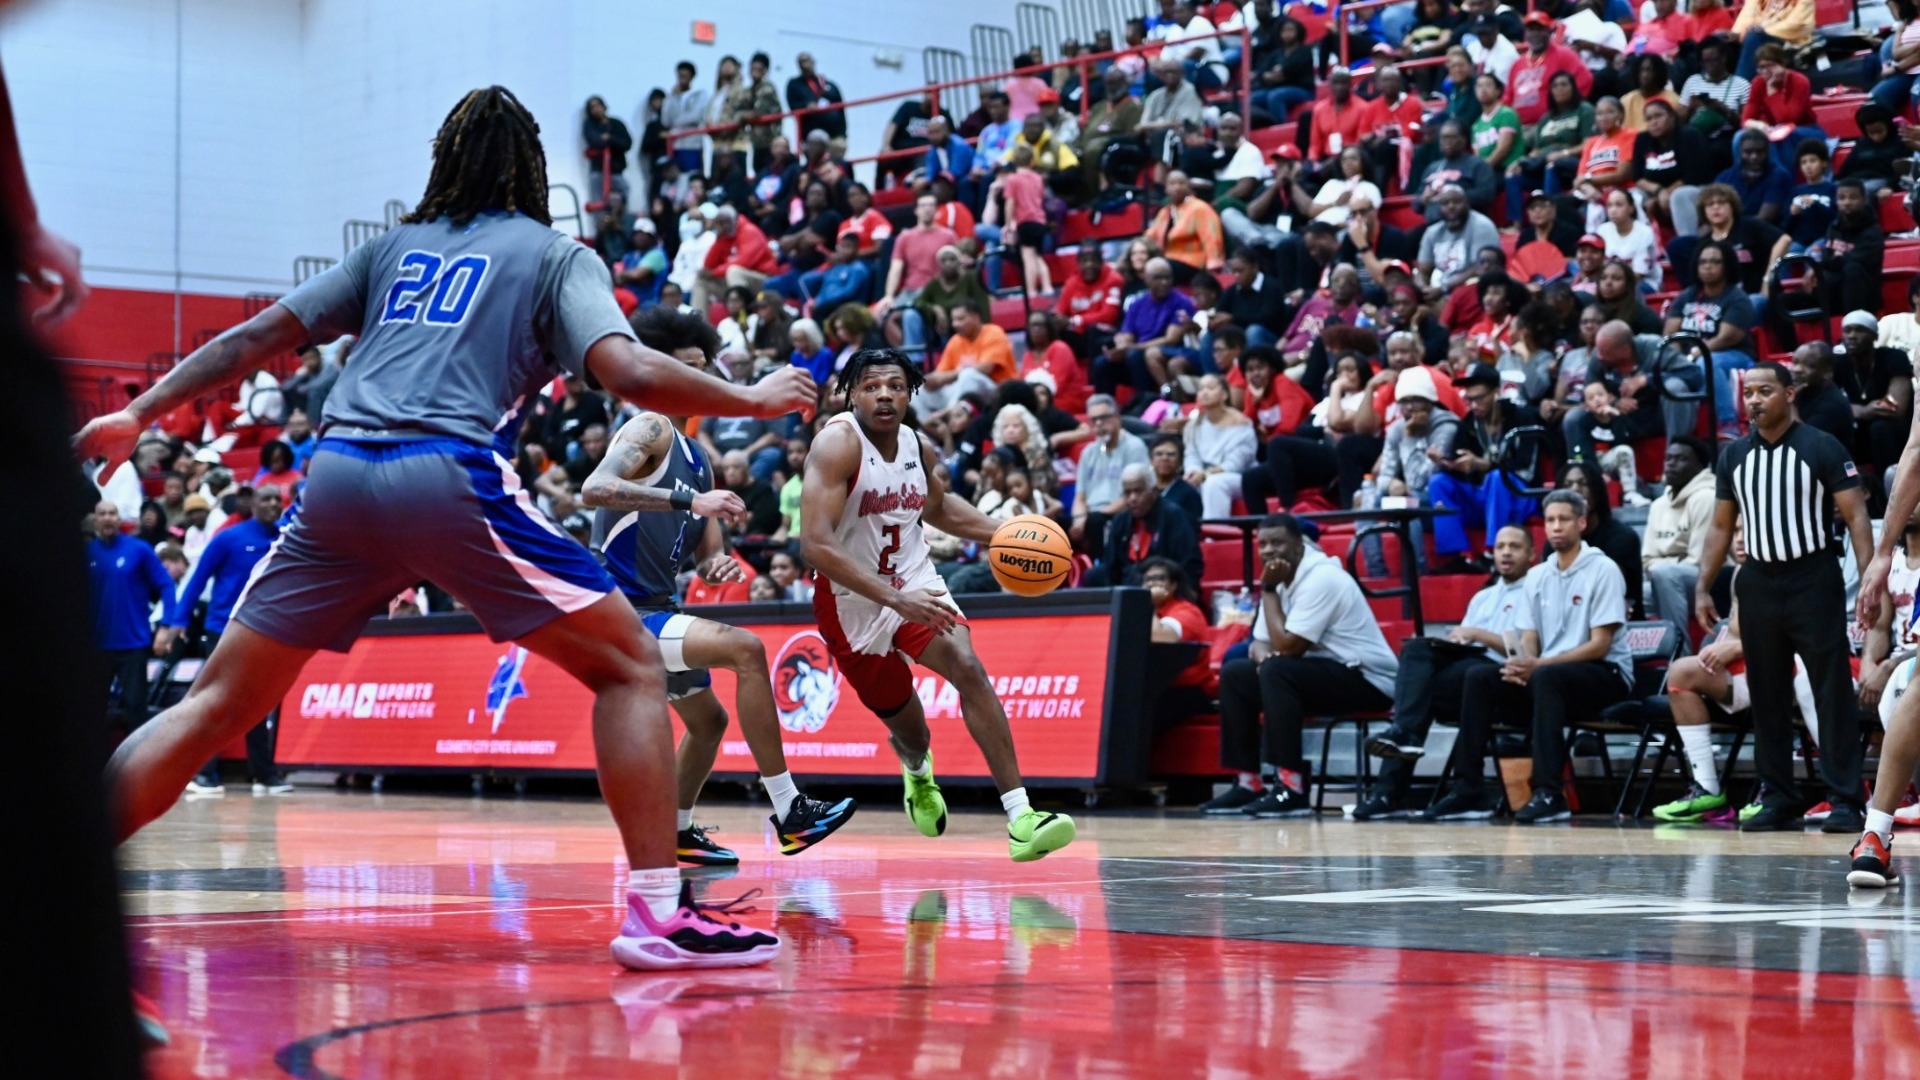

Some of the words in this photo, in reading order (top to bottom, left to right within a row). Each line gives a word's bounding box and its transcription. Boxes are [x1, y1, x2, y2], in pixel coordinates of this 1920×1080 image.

[379, 249, 490, 327] 20
[878, 524, 900, 575] 2
[999, 552, 1053, 574] Wilson
[377, 683, 434, 700] SPORTS
[996, 675, 1080, 695] SPORTS
[300, 683, 356, 718] CIAA
[372, 702, 436, 719] NETWORK
[1003, 698, 1085, 718] ETWORK
